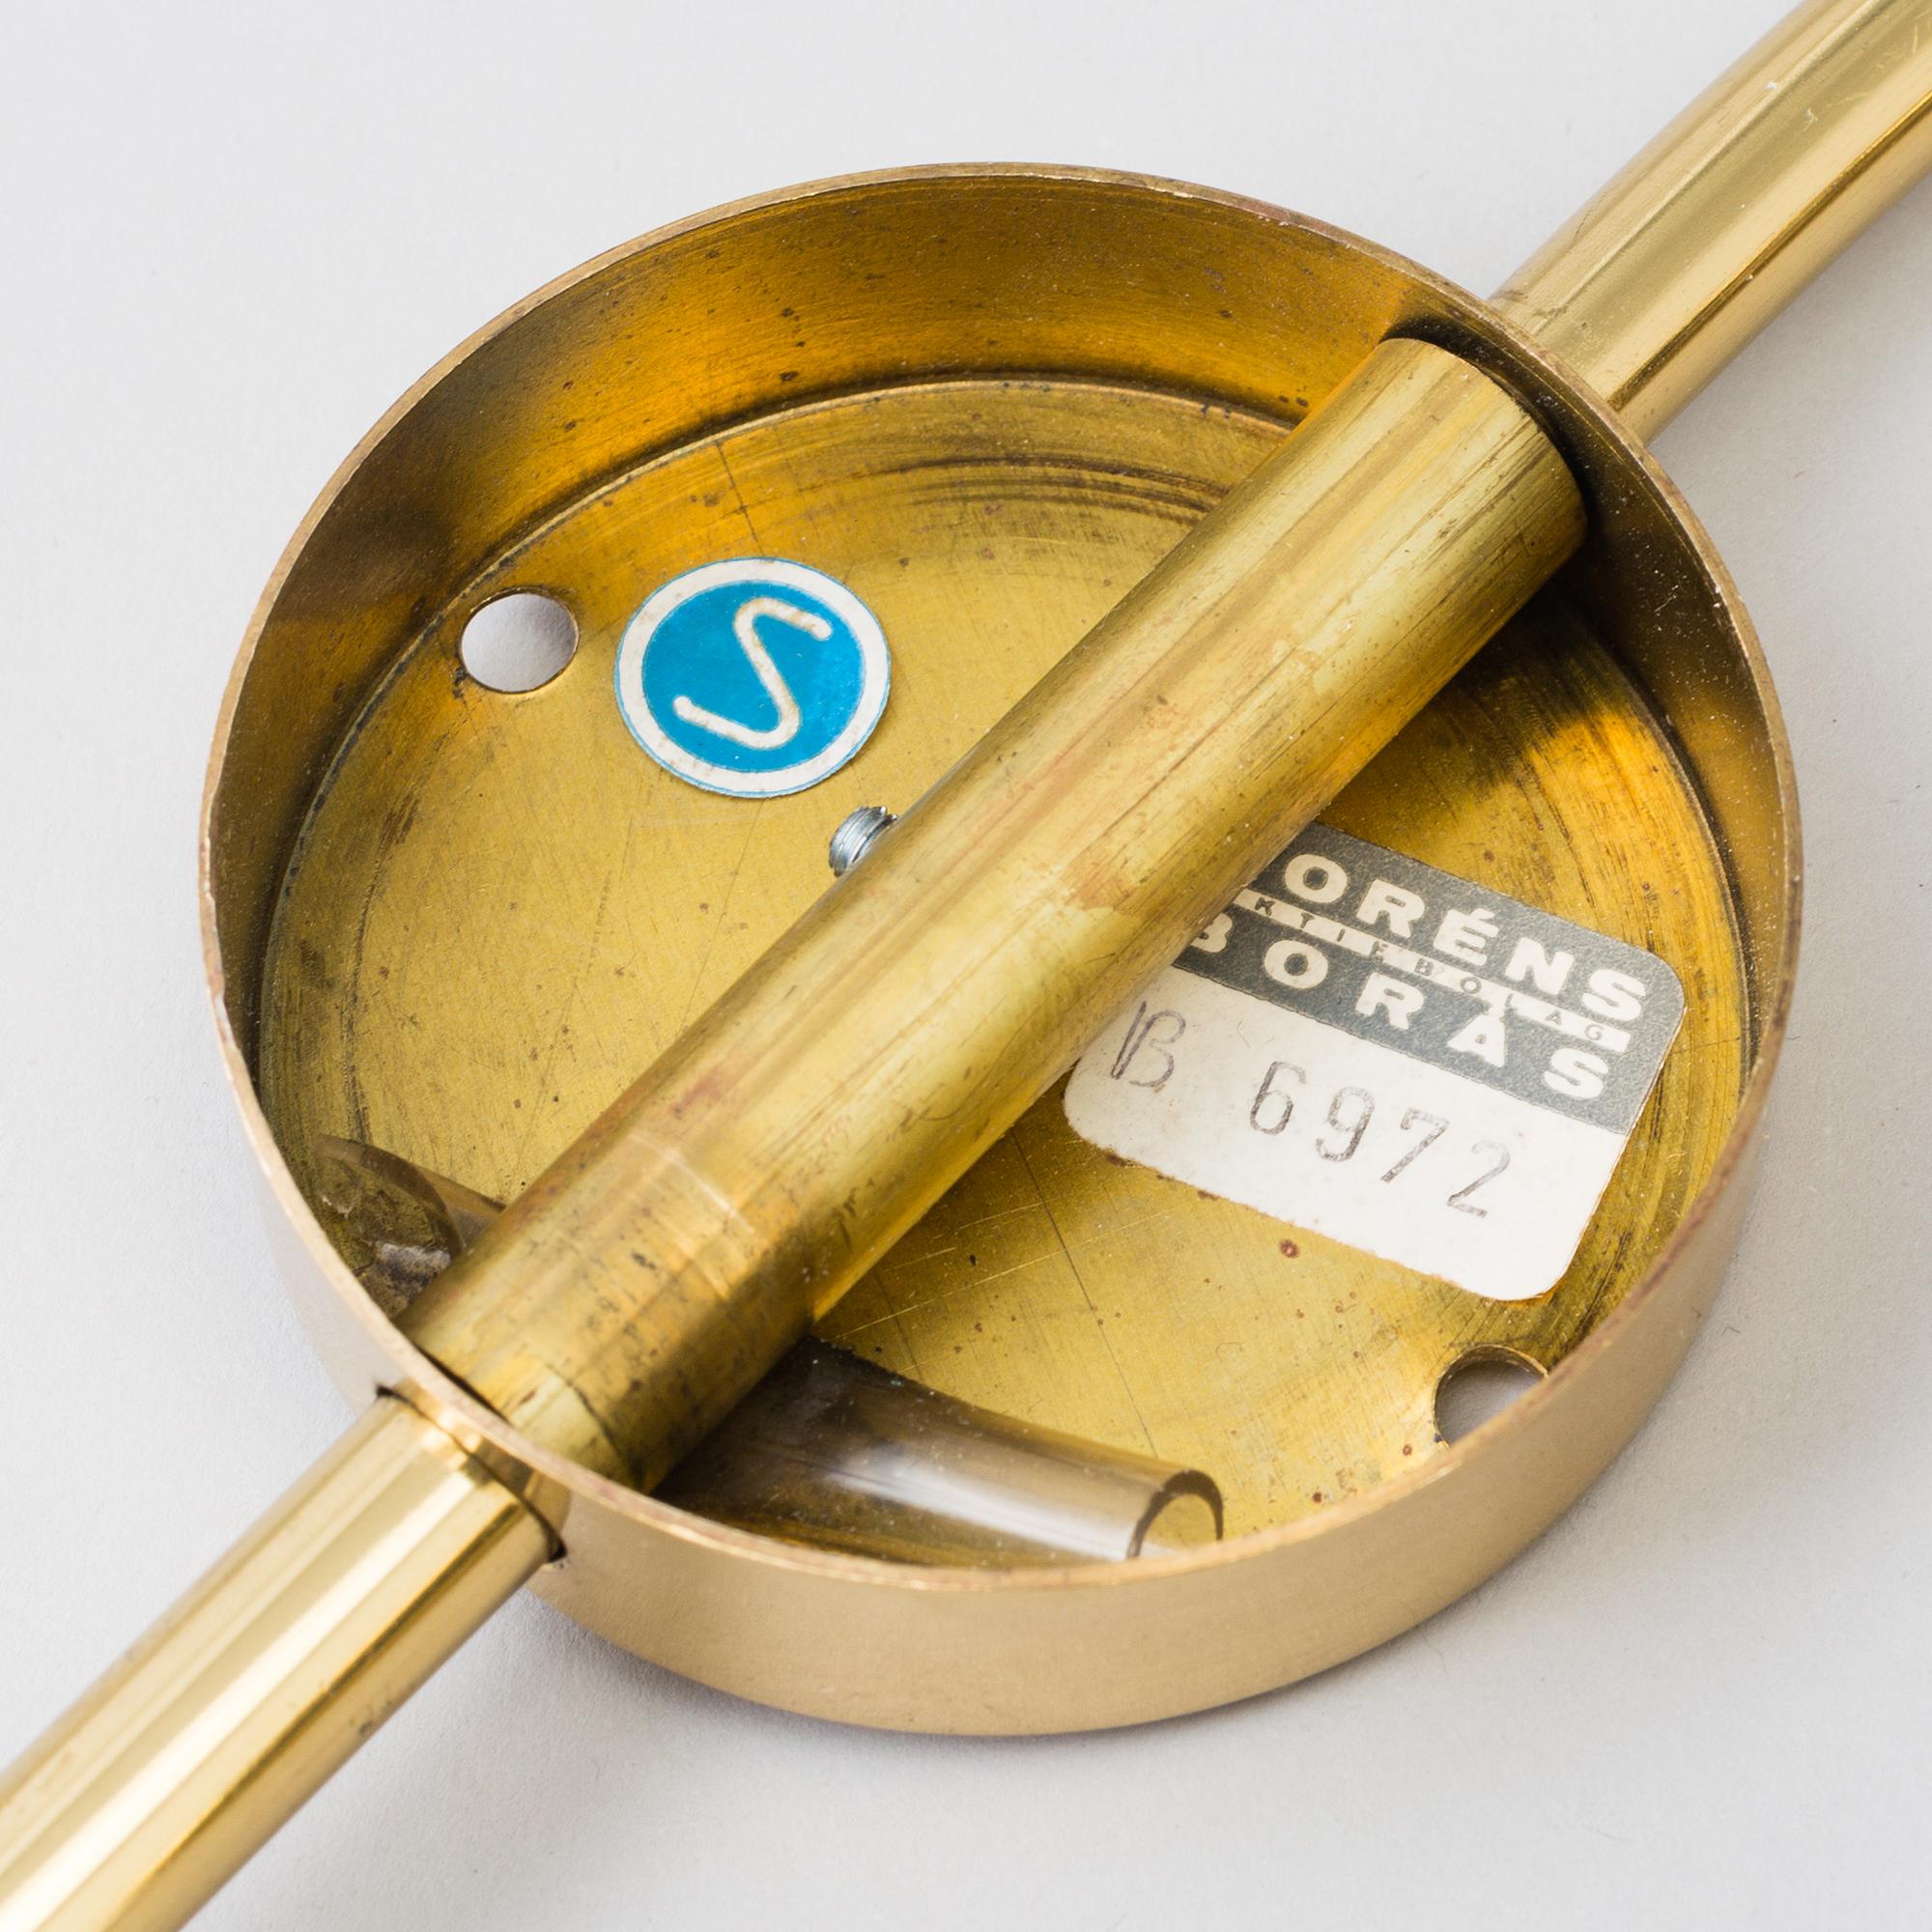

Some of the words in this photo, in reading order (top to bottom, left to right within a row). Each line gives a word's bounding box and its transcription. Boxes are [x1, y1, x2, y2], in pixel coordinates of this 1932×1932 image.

[672, 597, 833, 751] S
[1256, 896, 1604, 1041] KTIEBOLAG
[1285, 853, 1646, 1022] ORÉNS
[1111, 1001, 1186, 1088] B
[1250, 1061, 1511, 1217] 6972
